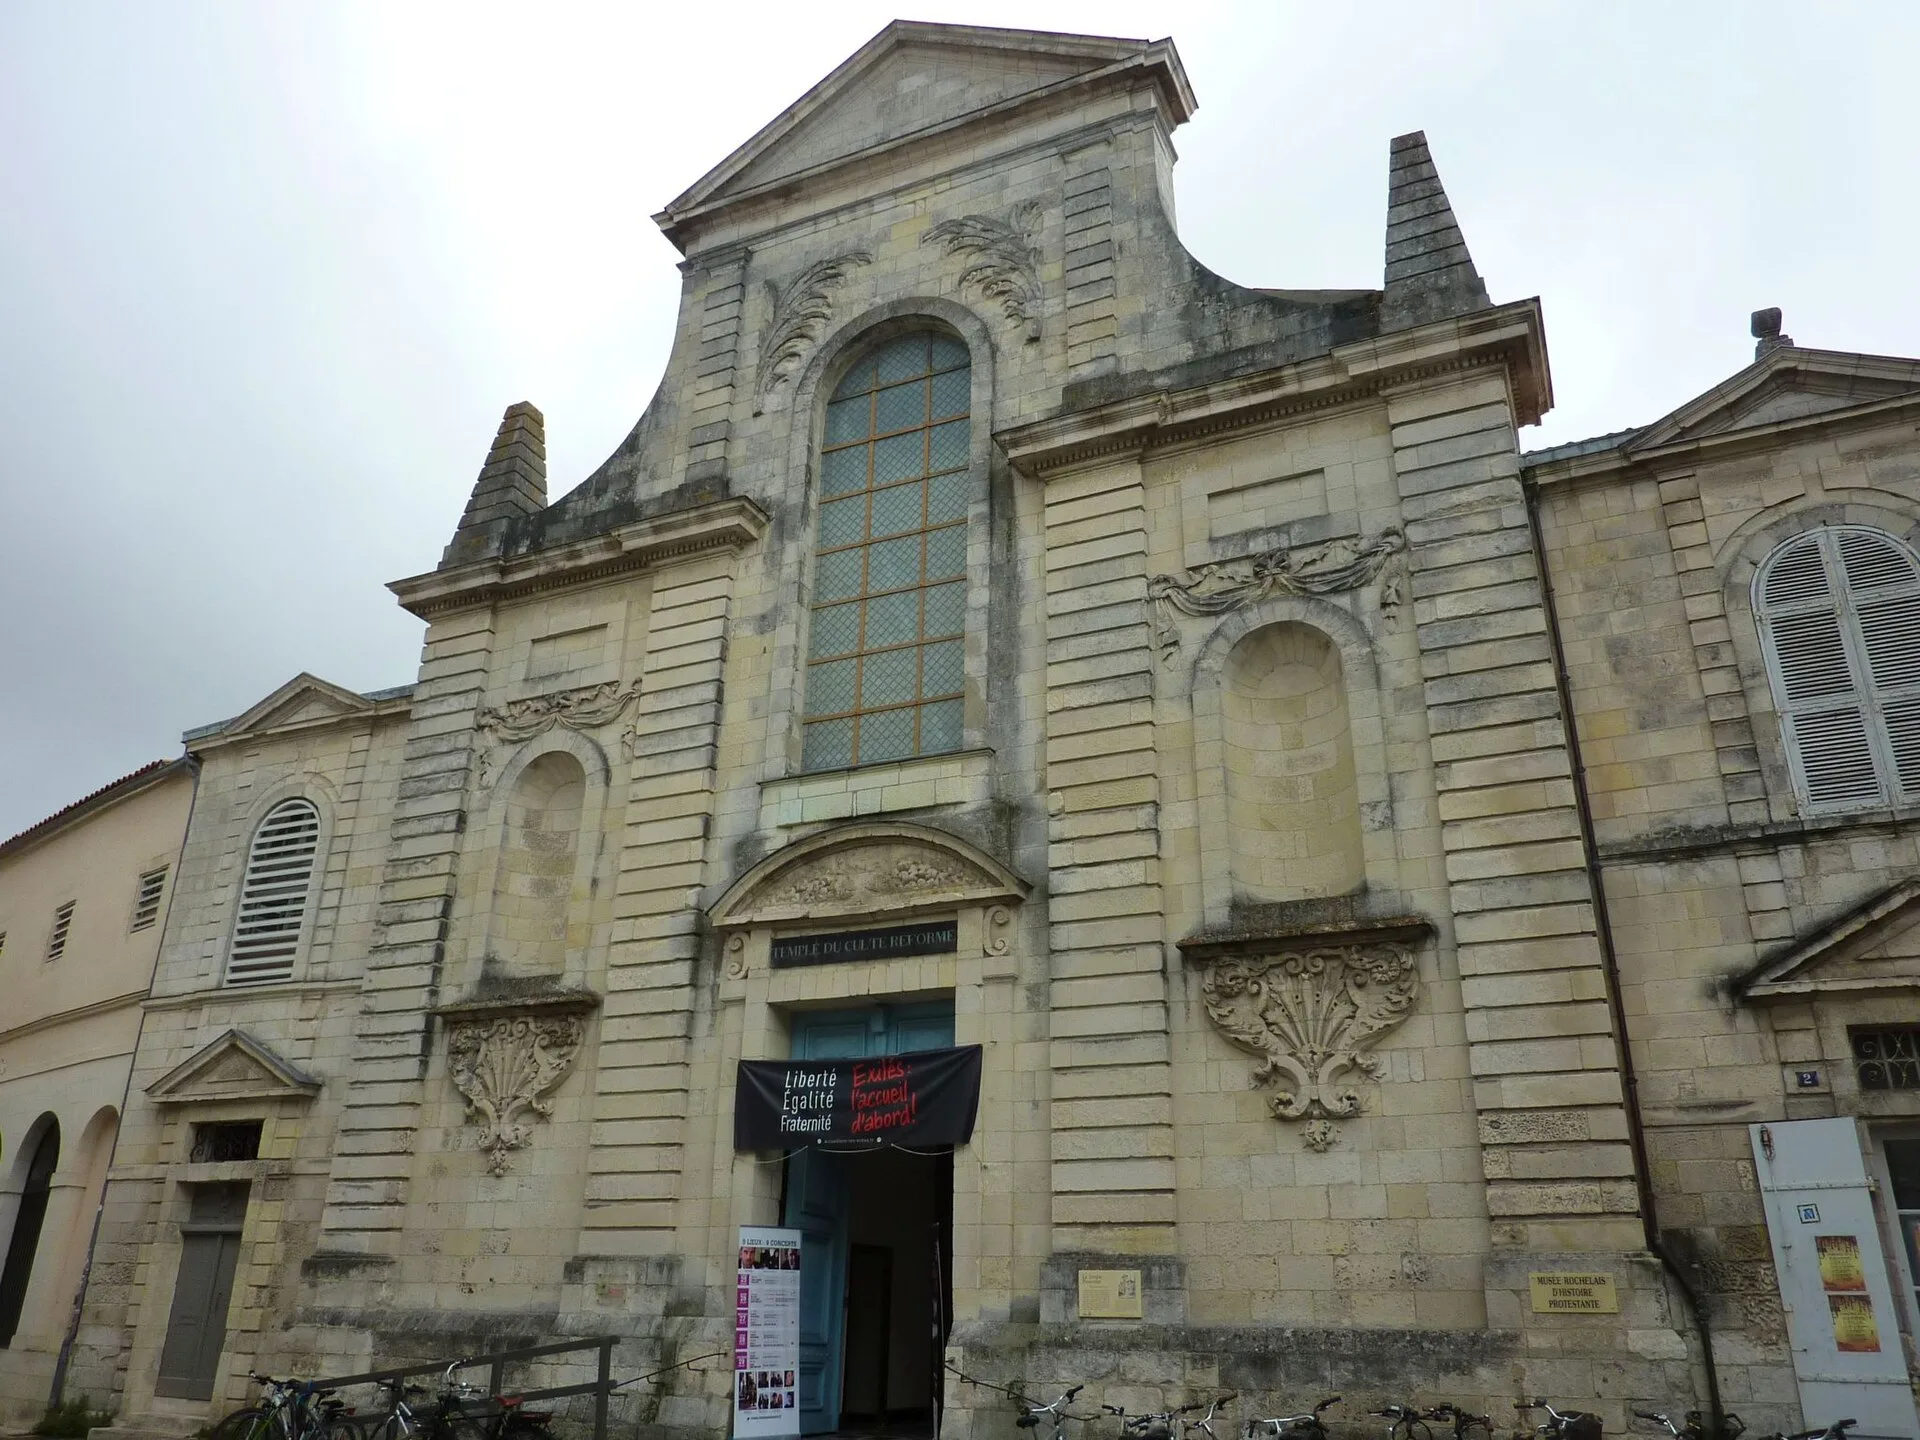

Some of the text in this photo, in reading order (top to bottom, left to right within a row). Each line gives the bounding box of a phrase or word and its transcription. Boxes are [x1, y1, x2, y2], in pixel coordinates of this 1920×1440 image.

[823, 941, 842, 955] DU
[844, 936, 887, 953] CULTE
[785, 1068, 837, 1088] Liberté
[1802, 1073, 1812, 1084] 2
[783, 1089, 835, 1114] Égalité
[850, 1080, 909, 1110] l'accueil
[780, 1114, 832, 1133] Fraternité
[770, 1239, 797, 1247] CONCERTS
[1564, 1276, 1606, 1285] ROCHELAIS
[1552, 1288, 1594, 1297] D'HISTOIRE
[1548, 1300, 1600, 1309] PROTESTANTE
